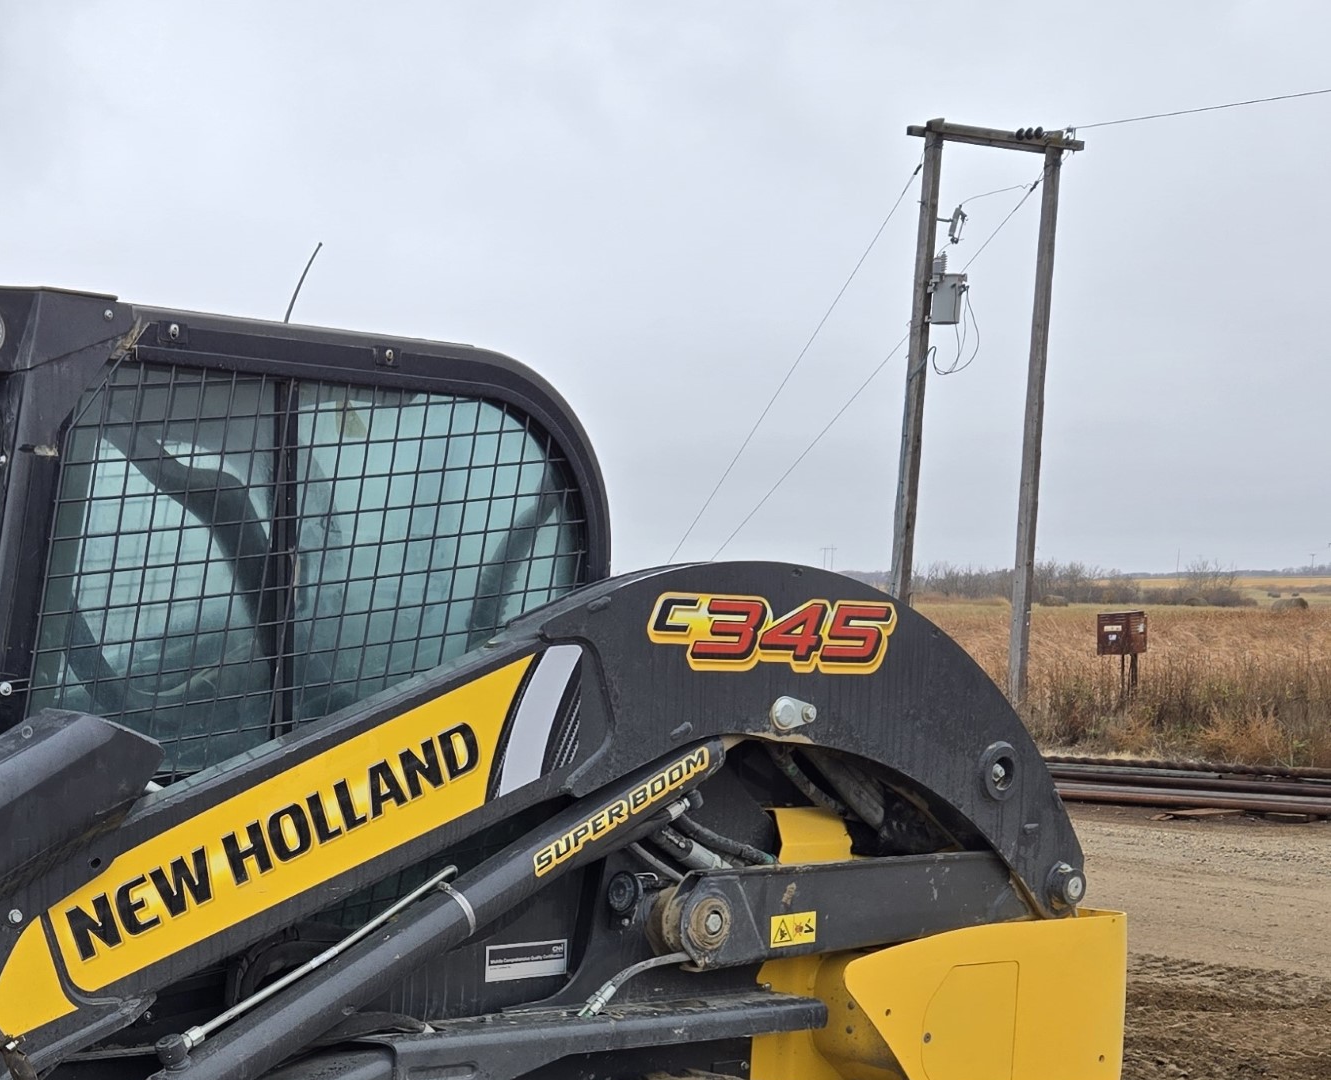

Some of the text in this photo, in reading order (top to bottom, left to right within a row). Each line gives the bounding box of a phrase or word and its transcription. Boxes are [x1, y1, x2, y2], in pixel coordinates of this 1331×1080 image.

[649, 595, 895, 668] C345
[65, 721, 481, 962] NEW HOLLAND
[534, 747, 710, 877] SUPER BOOM
